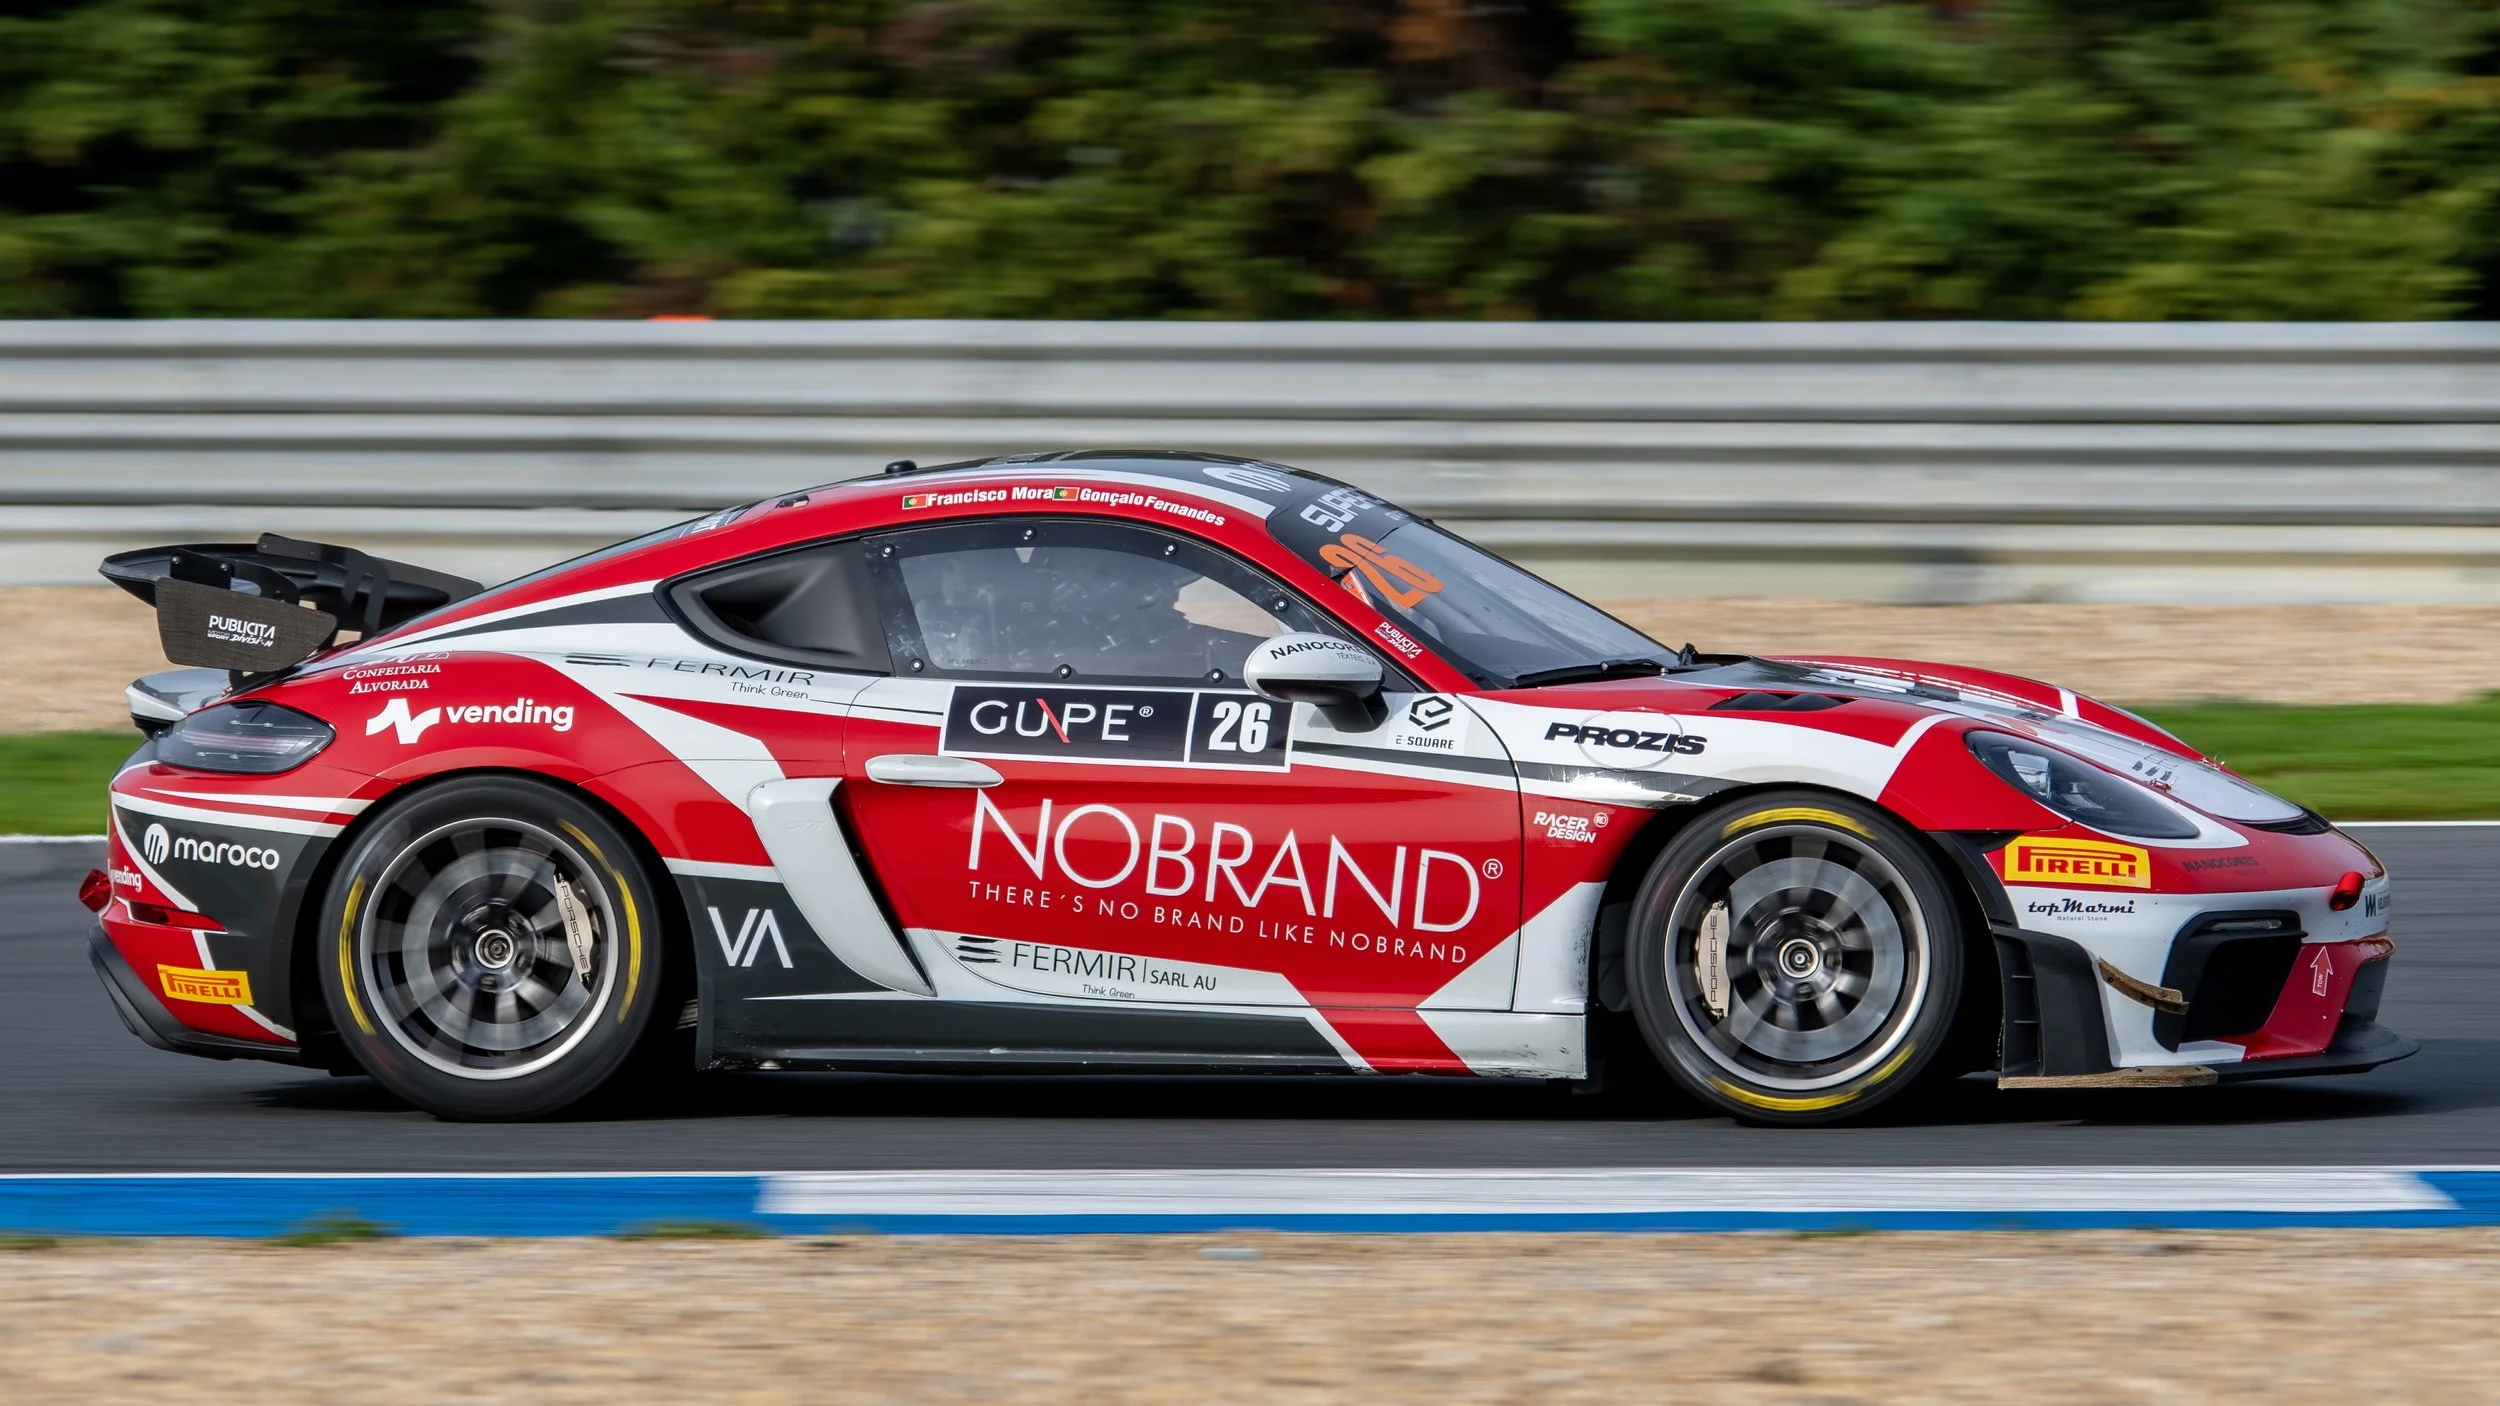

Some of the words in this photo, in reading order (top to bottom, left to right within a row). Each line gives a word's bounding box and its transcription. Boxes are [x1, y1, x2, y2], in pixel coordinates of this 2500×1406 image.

[928, 489, 1007, 506] Francisco
[1011, 487, 1053, 500] Mora
[1079, 488, 1144, 506] Gonçalo
[1144, 496, 1226, 526] Fernandes
[1319, 533, 1444, 610] 26
[647, 658, 815, 686] FERMIR
[731, 681, 767, 695] Think
[770, 686, 808, 700] Green
[446, 697, 574, 732] vending
[1208, 701, 1272, 753] 26
[1544, 722, 1707, 755] PROZIS
[1533, 811, 1589, 831] RACER
[1547, 827, 1597, 843] DESIGN
[174, 837, 280, 871] maroco
[2017, 845, 2137, 878] PIRELLI
[561, 885, 589, 970] PORSCHE
[1099, 899, 1139, 920] NO
[1154, 906, 1244, 934] BRAND
[1259, 920, 1315, 944] LIKE
[1330, 930, 1467, 964] NOBRAND
[1013, 943, 1136, 983] FERMIR
[1150, 969, 1190, 989] SARL
[1193, 975, 1217, 991] AU
[1710, 915, 1718, 1003] PORSCHE
[165, 972, 243, 999] PIRELLI
[1082, 984, 1107, 997] Think
[1109, 985, 1136, 999] Green
